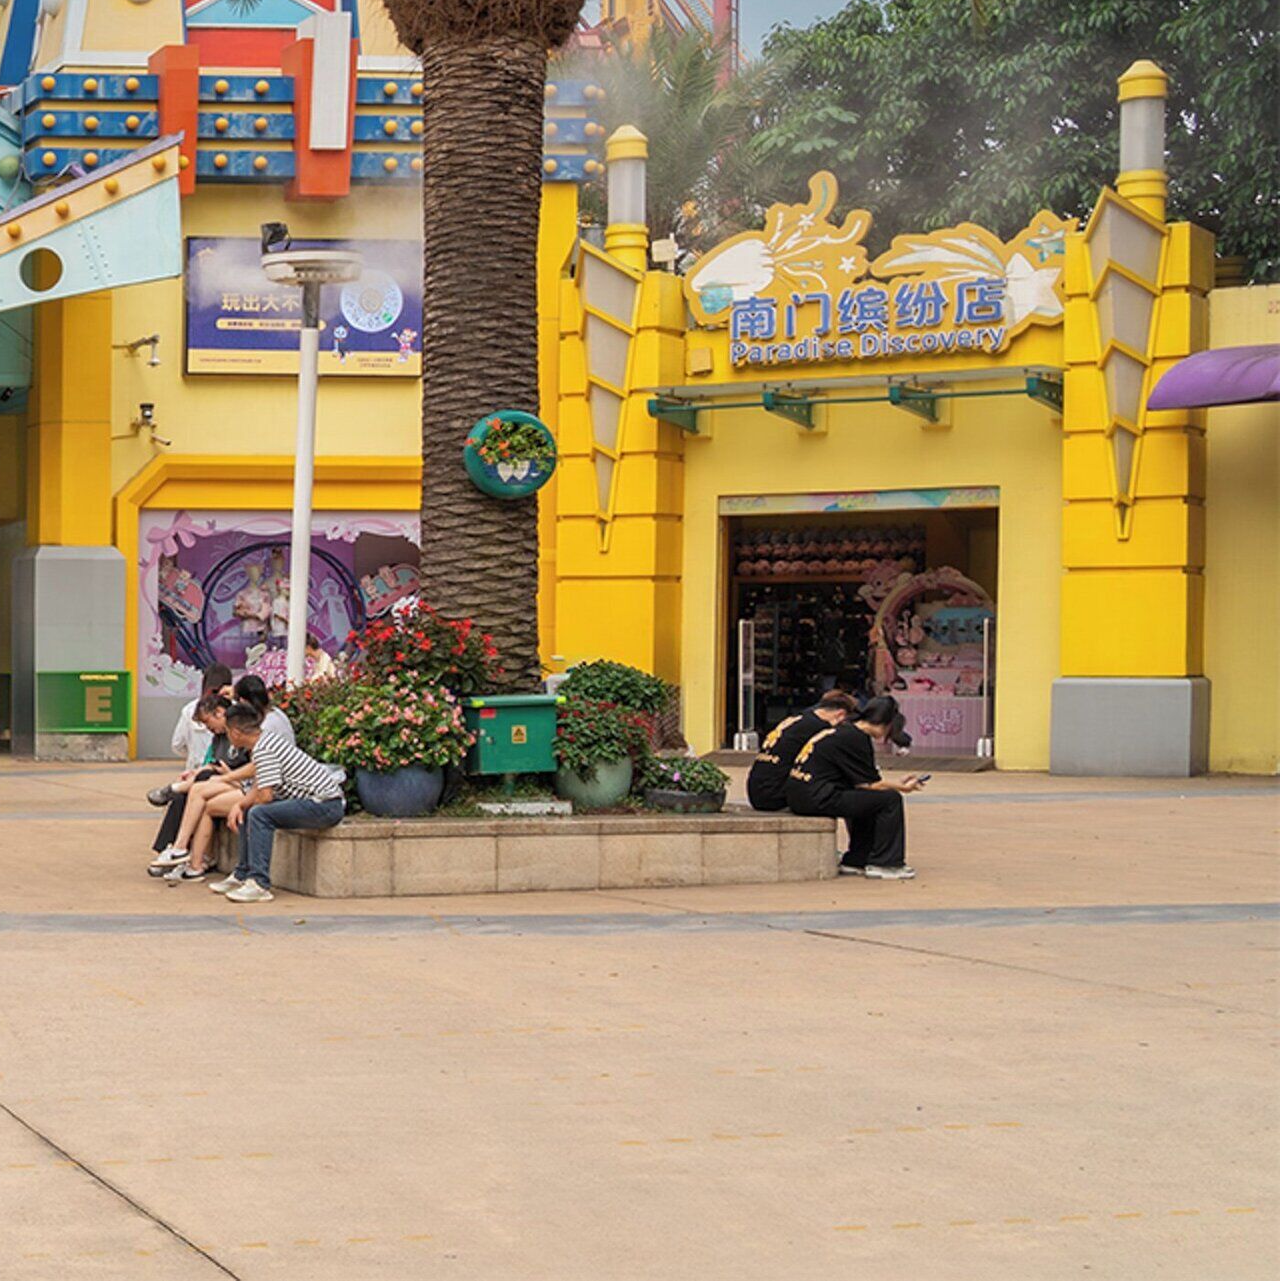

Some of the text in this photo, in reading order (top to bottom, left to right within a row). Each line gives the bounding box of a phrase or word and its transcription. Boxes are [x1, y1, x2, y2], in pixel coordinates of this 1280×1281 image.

[221, 293, 300, 312] 玩出大不
[730, 277, 1007, 341] 南门缤纷店
[731, 326, 1005, 364] Paradise Discovery
[85, 686, 112, 722] E
